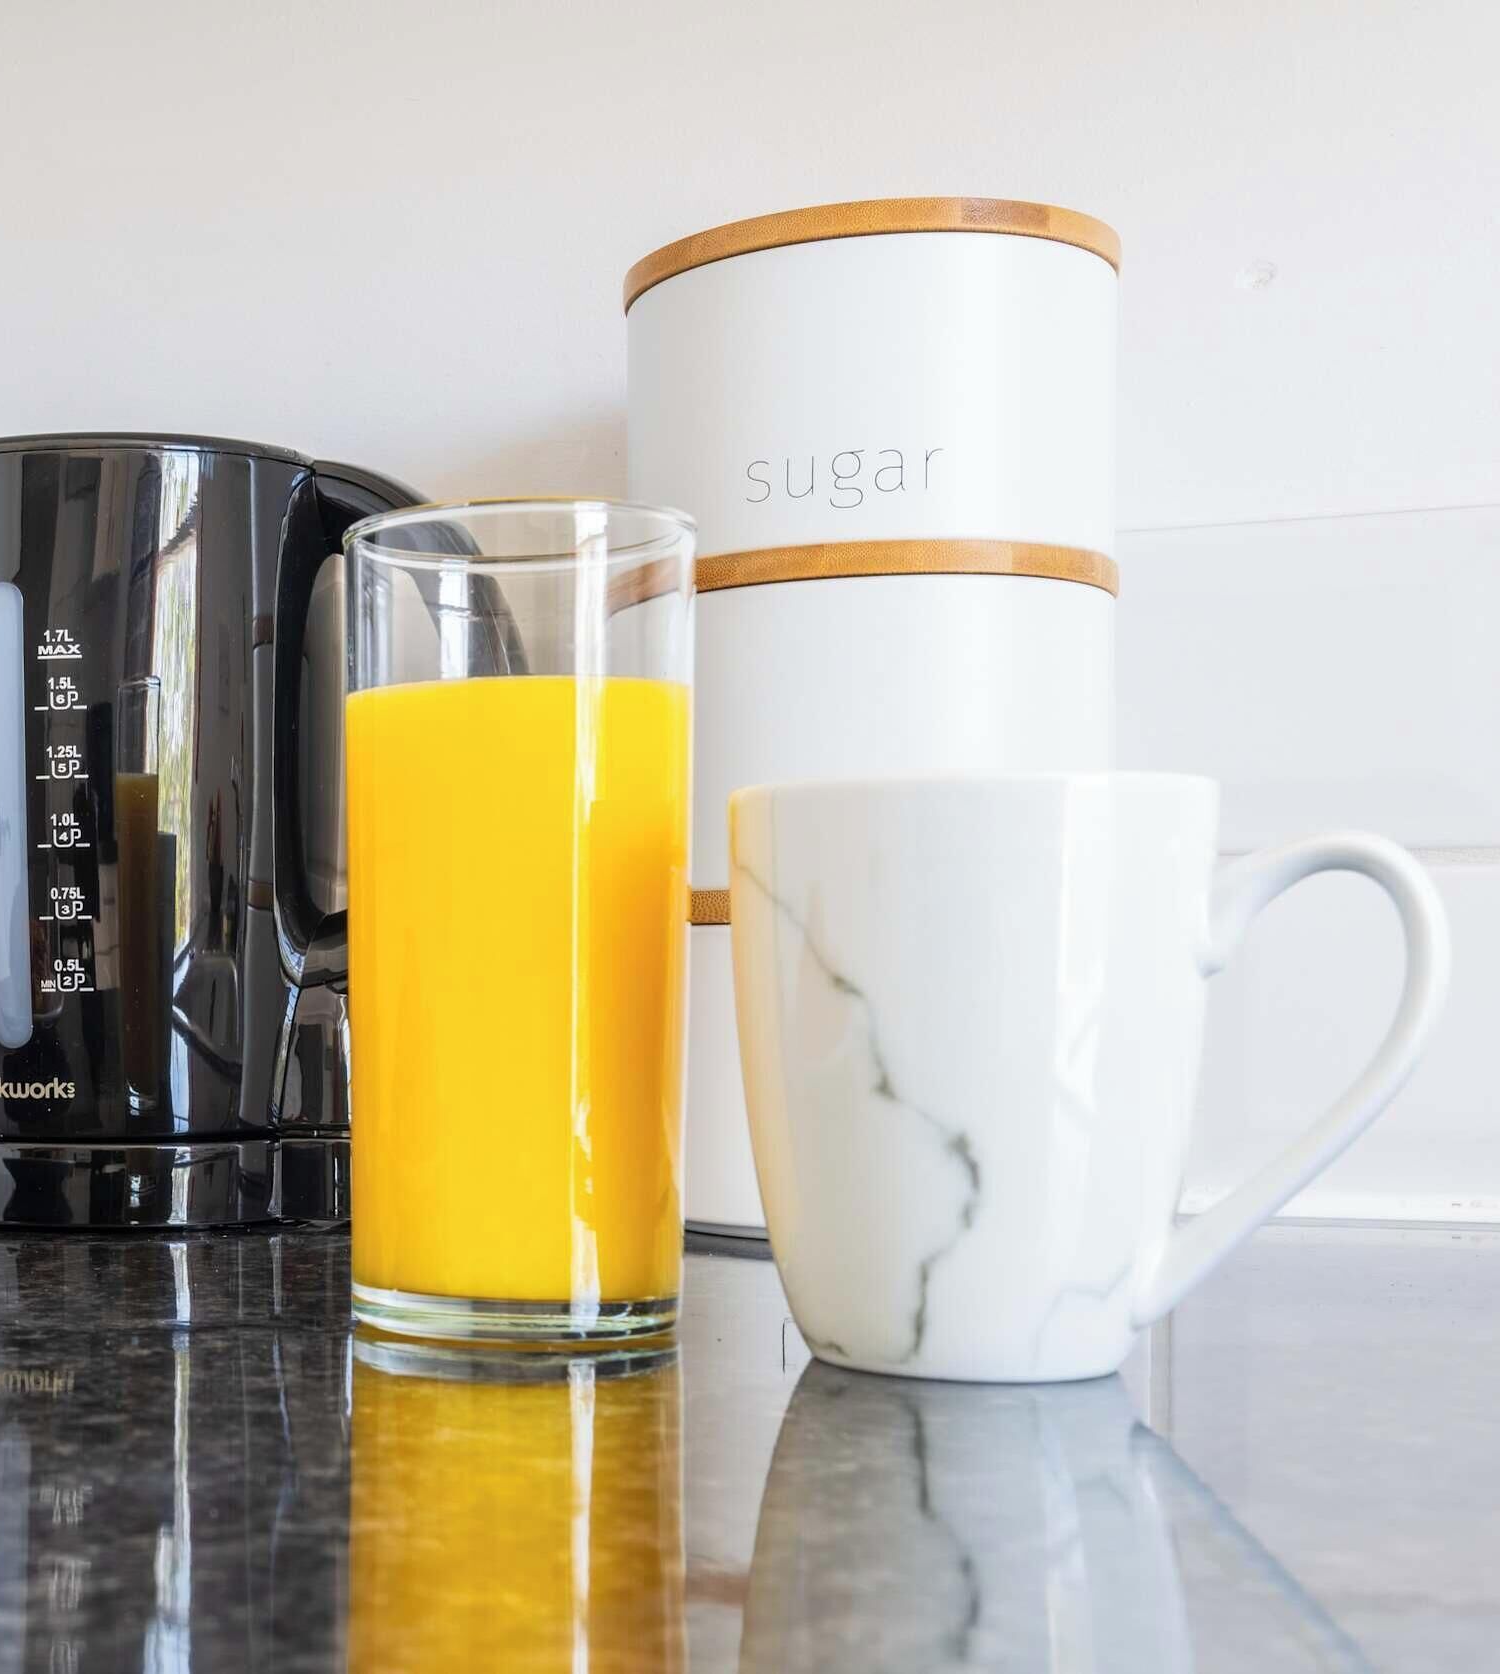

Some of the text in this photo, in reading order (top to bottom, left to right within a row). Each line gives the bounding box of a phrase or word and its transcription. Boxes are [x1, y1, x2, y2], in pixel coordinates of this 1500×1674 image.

[746, 448, 944, 509] sugar
[43, 629, 74, 643] 1.7L
[38, 644, 81, 655] MAX
[48, 677, 76, 689] 1.5L
[46, 746, 82, 758] 1.25L
[50, 813, 79, 826] 1.0L
[50, 887, 85, 900] 0.75L
[54, 959, 84, 972] 0.5L
[41, 980, 56, 988] MIN
